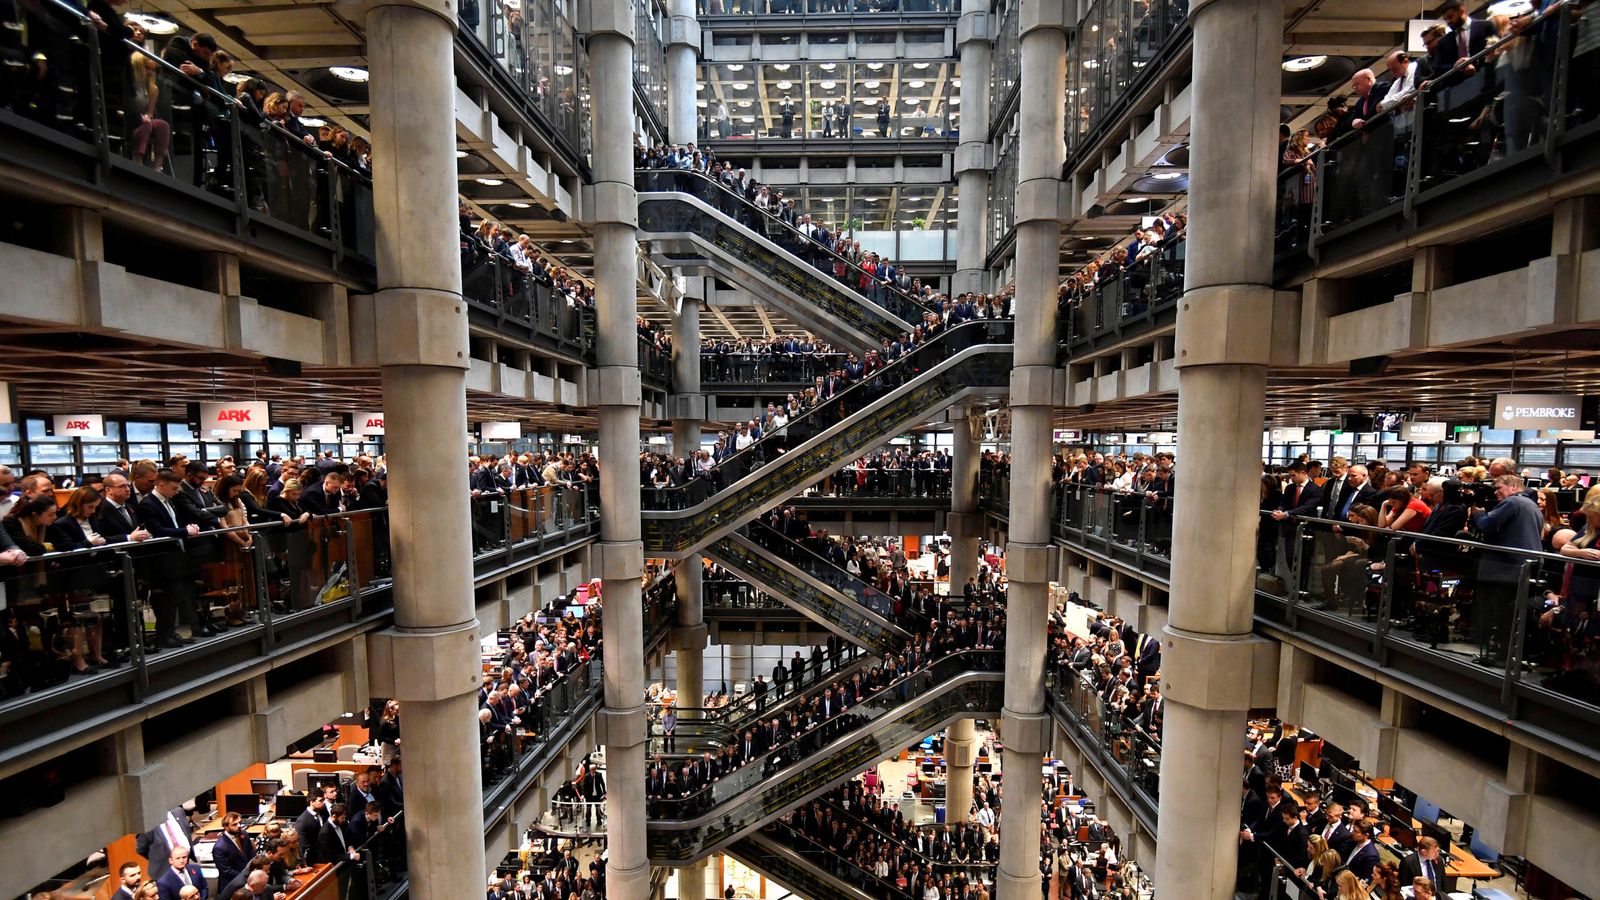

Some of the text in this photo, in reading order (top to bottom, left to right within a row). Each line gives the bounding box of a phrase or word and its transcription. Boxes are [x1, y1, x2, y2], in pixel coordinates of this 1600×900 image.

[217, 409, 252, 423] ARK
[1515, 407, 1576, 418] PEMBROKE
[66, 420, 90, 430] ARK
[365, 418, 385, 428] AR
